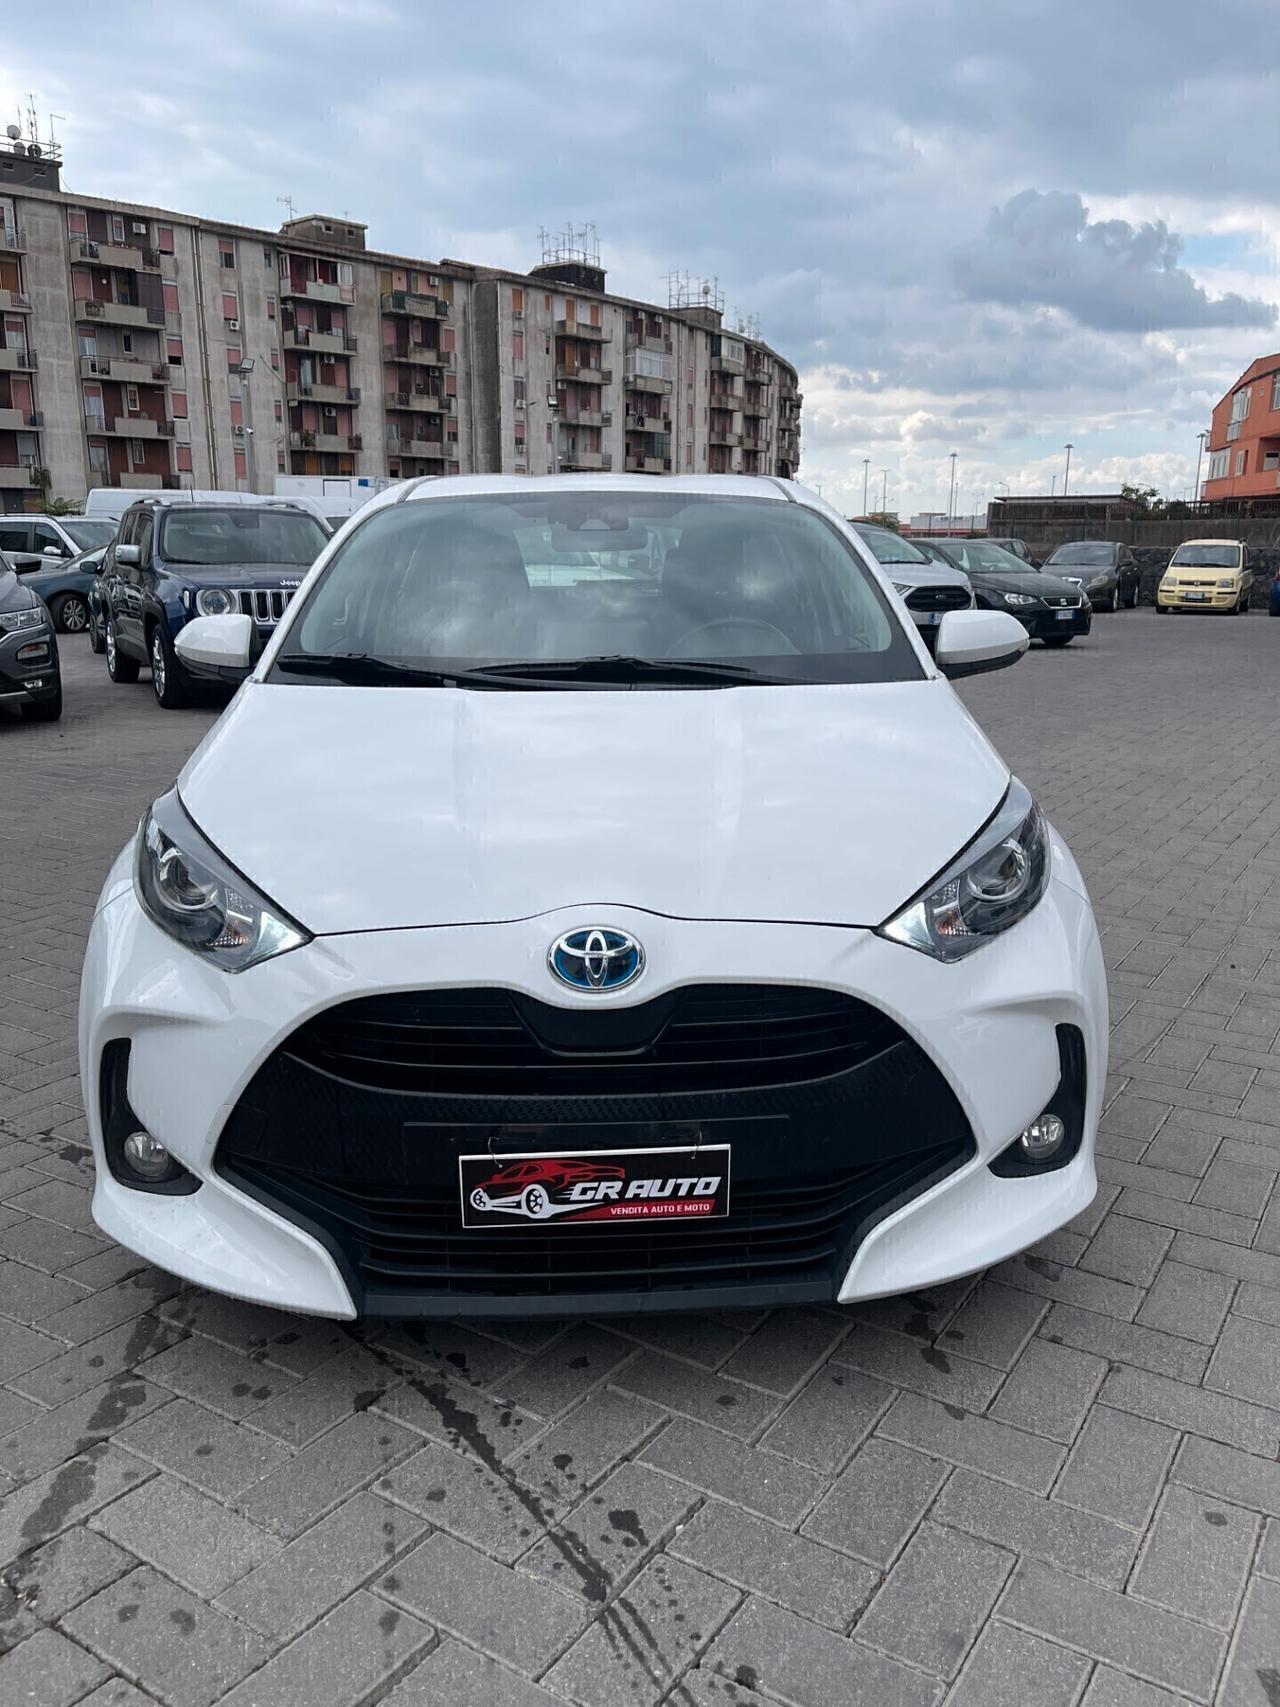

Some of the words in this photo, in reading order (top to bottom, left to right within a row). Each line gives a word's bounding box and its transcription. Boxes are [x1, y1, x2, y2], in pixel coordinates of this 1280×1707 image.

[569, 1181, 624, 1200] GR
[625, 1176, 722, 1199] AUTO
[610, 1206, 649, 1215] VENDITA
[651, 1205, 675, 1214] AUTO
[676, 1204, 682, 1212] E
[684, 1203, 710, 1212] MOTO
